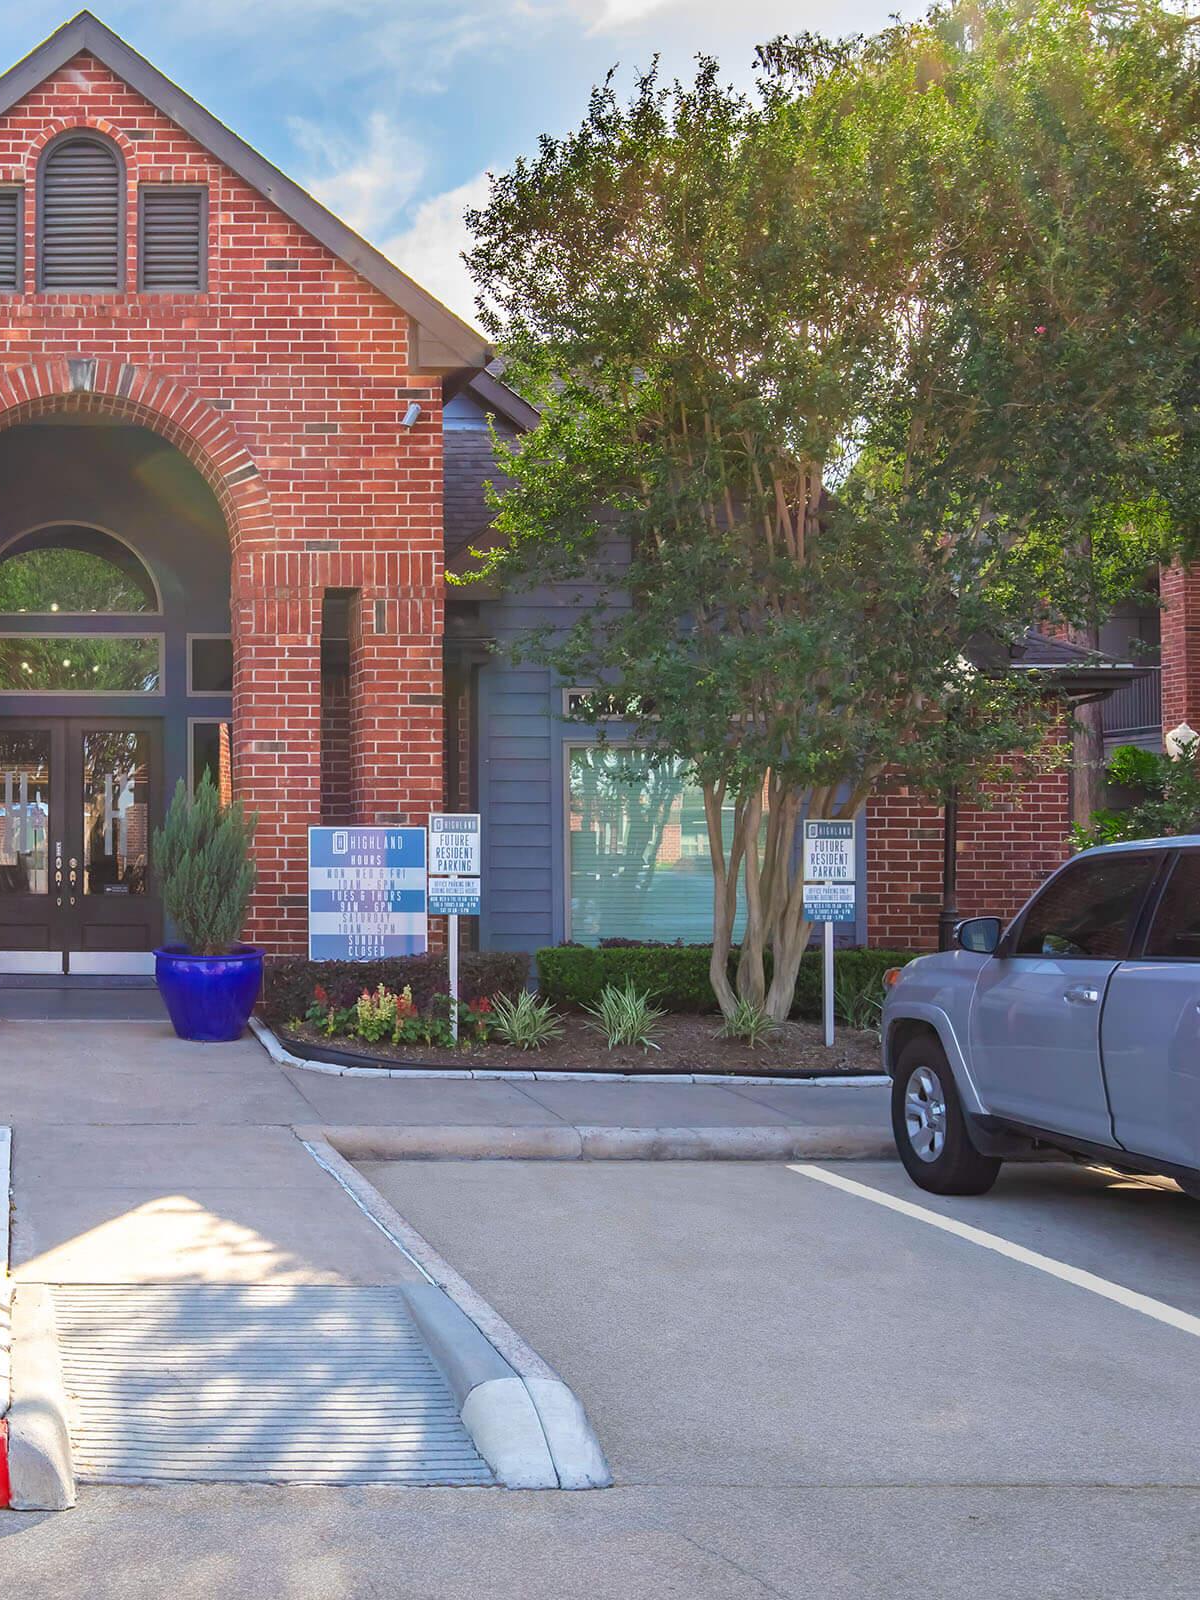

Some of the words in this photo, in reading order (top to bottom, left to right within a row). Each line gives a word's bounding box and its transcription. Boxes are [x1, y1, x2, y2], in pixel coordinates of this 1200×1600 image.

[350, 836, 403, 850] HIGHLAND
[440, 834, 469, 846] FUTURE
[814, 841, 844, 852] FUTURE
[435, 847, 473, 859] RESIDENT
[351, 855, 381, 865] HOURS
[810, 853, 848, 865] RESIDENT
[438, 860, 472, 871] PARKING
[390, 869, 406, 879] FRI
[813, 866, 847, 877] PARKING
[331, 891, 355, 901] TUES
[360, 891, 365, 901] &
[371, 891, 402, 901] THURS
[340, 902, 358, 912] 9AM
[342, 913, 390, 924] SATURDAY
[338, 924, 360, 934] 10AM
[348, 935, 385, 945] SUNDAY
[348, 946, 385, 956] CLOSED
